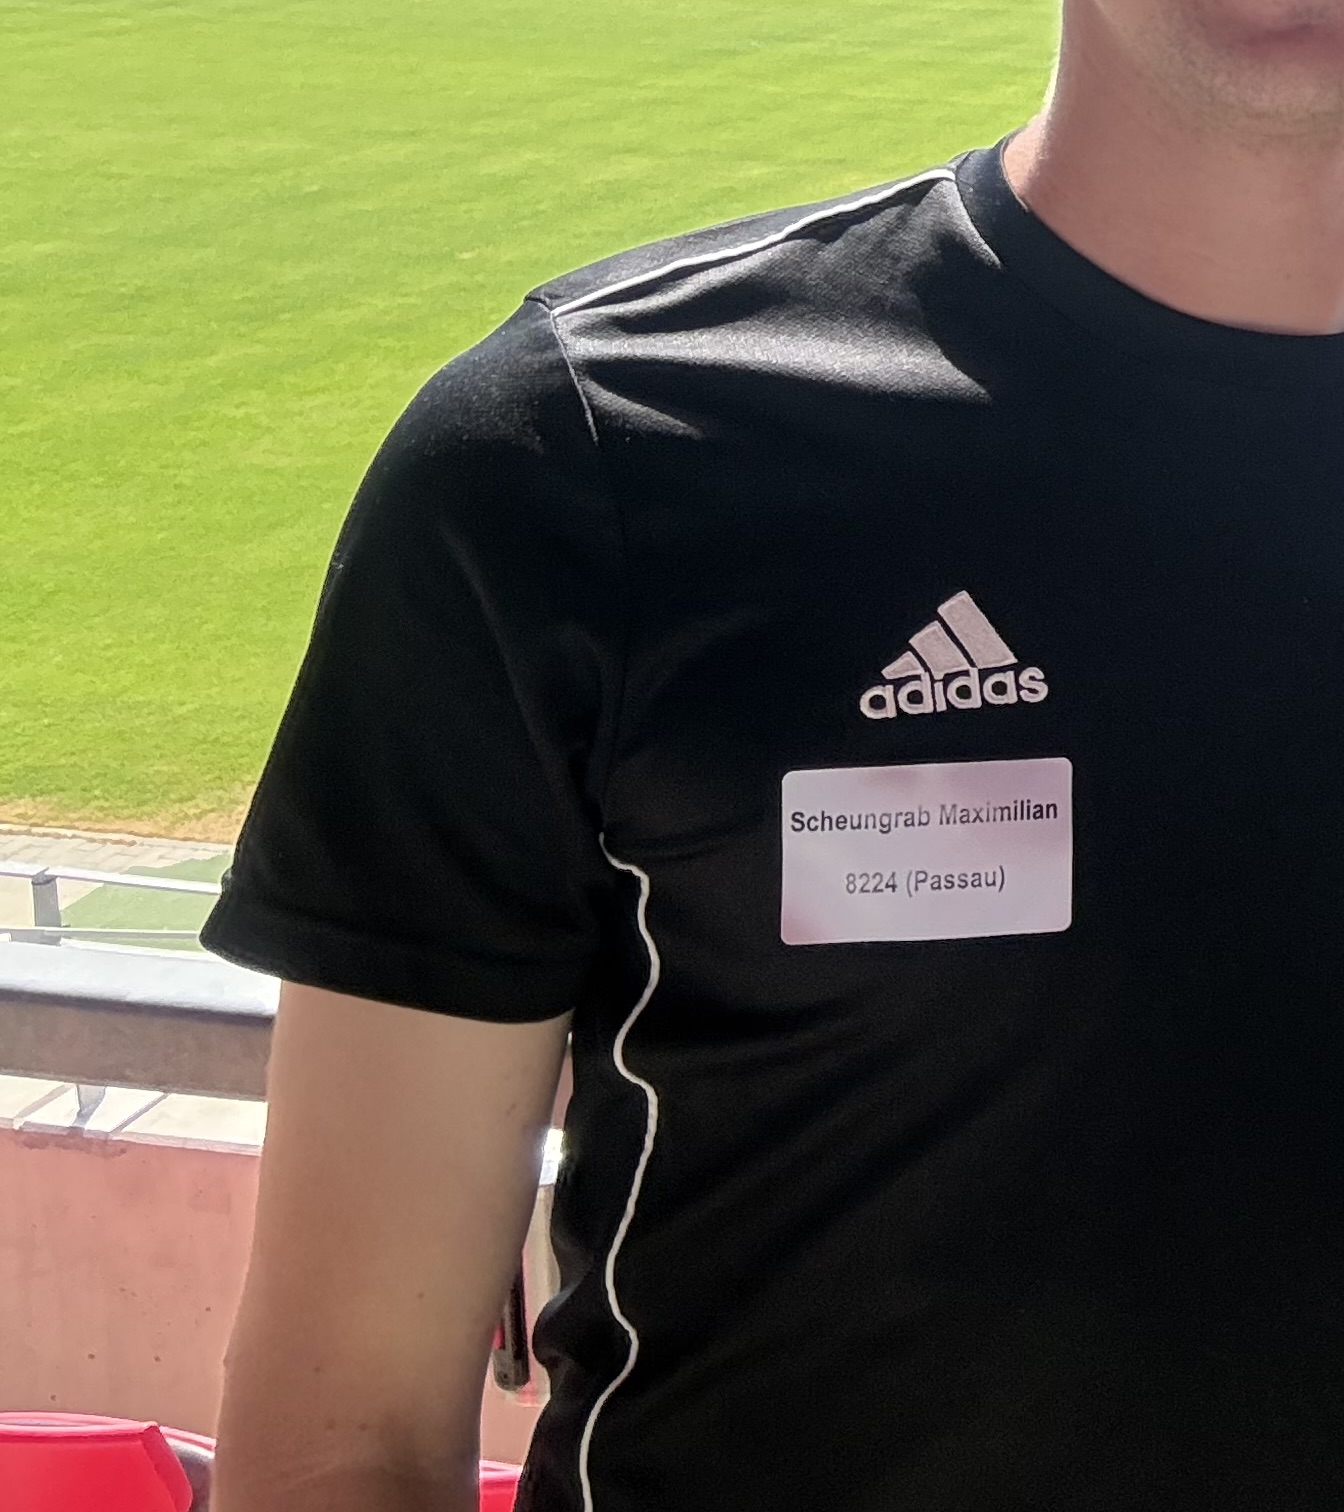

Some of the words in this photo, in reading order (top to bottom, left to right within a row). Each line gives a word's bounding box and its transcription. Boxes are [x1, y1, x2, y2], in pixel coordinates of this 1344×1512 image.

[860, 667, 1048, 719] adidas
[790, 806, 930, 834] Scheungrab
[939, 799, 1058, 826] Maximilian
[845, 871, 898, 894] 8224
[906, 865, 1005, 897] (Passau)
